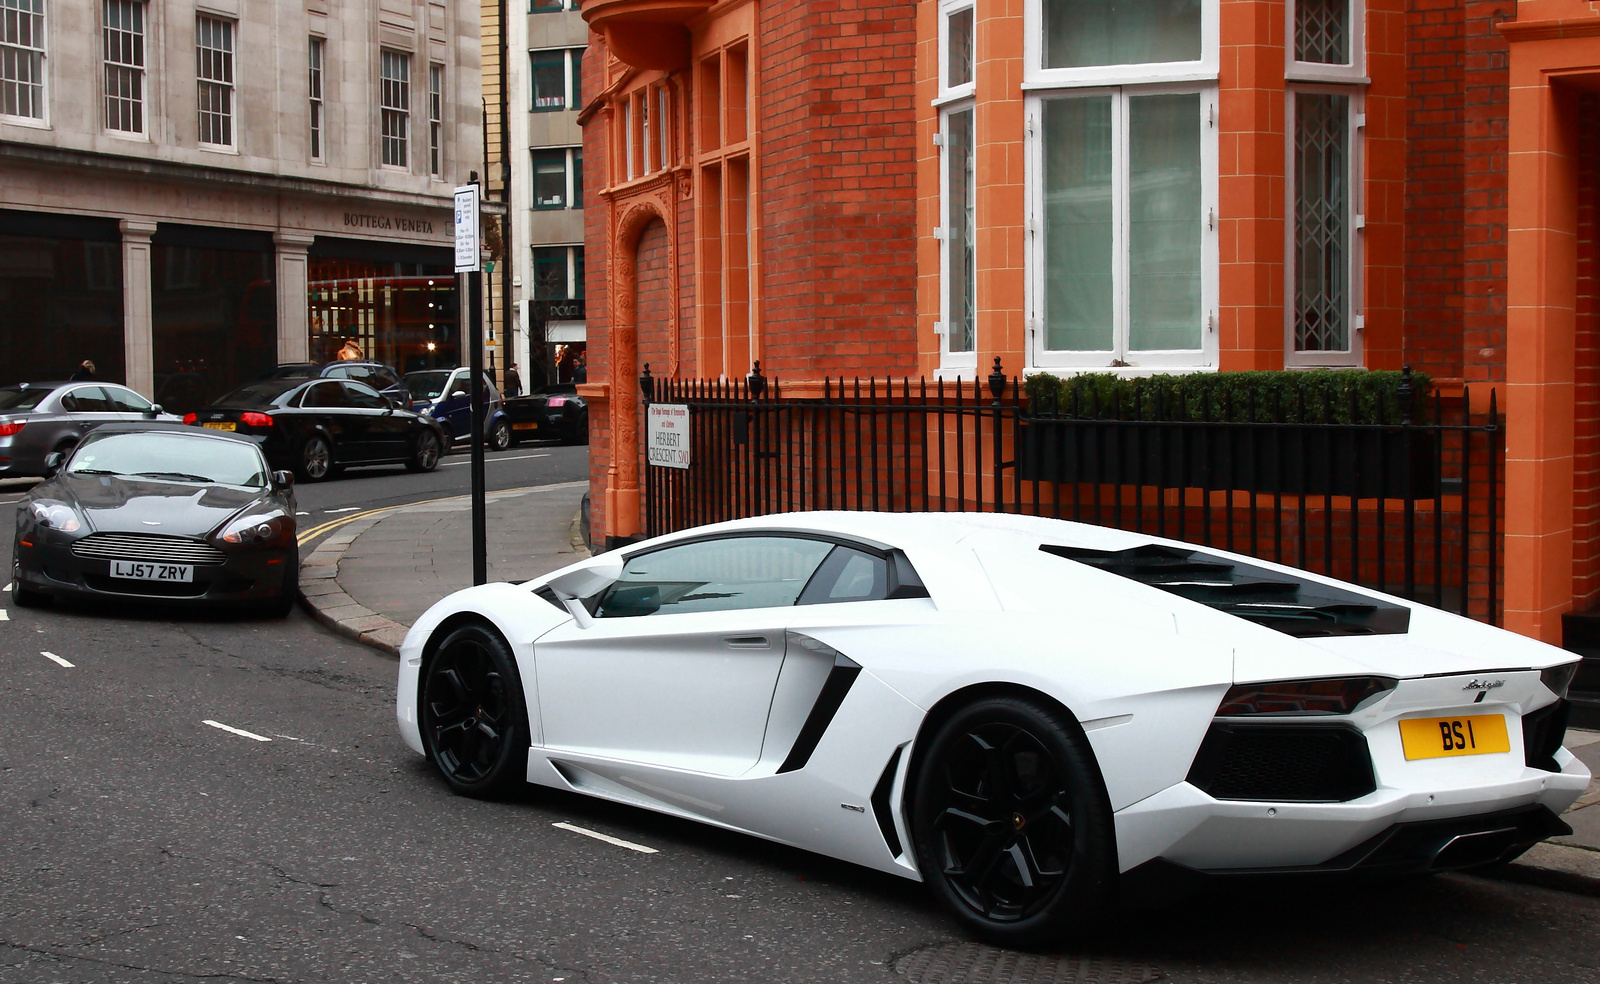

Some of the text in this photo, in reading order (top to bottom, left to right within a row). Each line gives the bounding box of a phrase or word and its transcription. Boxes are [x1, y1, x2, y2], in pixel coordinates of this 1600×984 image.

[343, 212, 392, 230] BOTTEGA
[394, 218, 433, 234] VENETA
[655, 431, 681, 447] HERBERT
[115, 562, 187, 580] LJ57 ZRY
